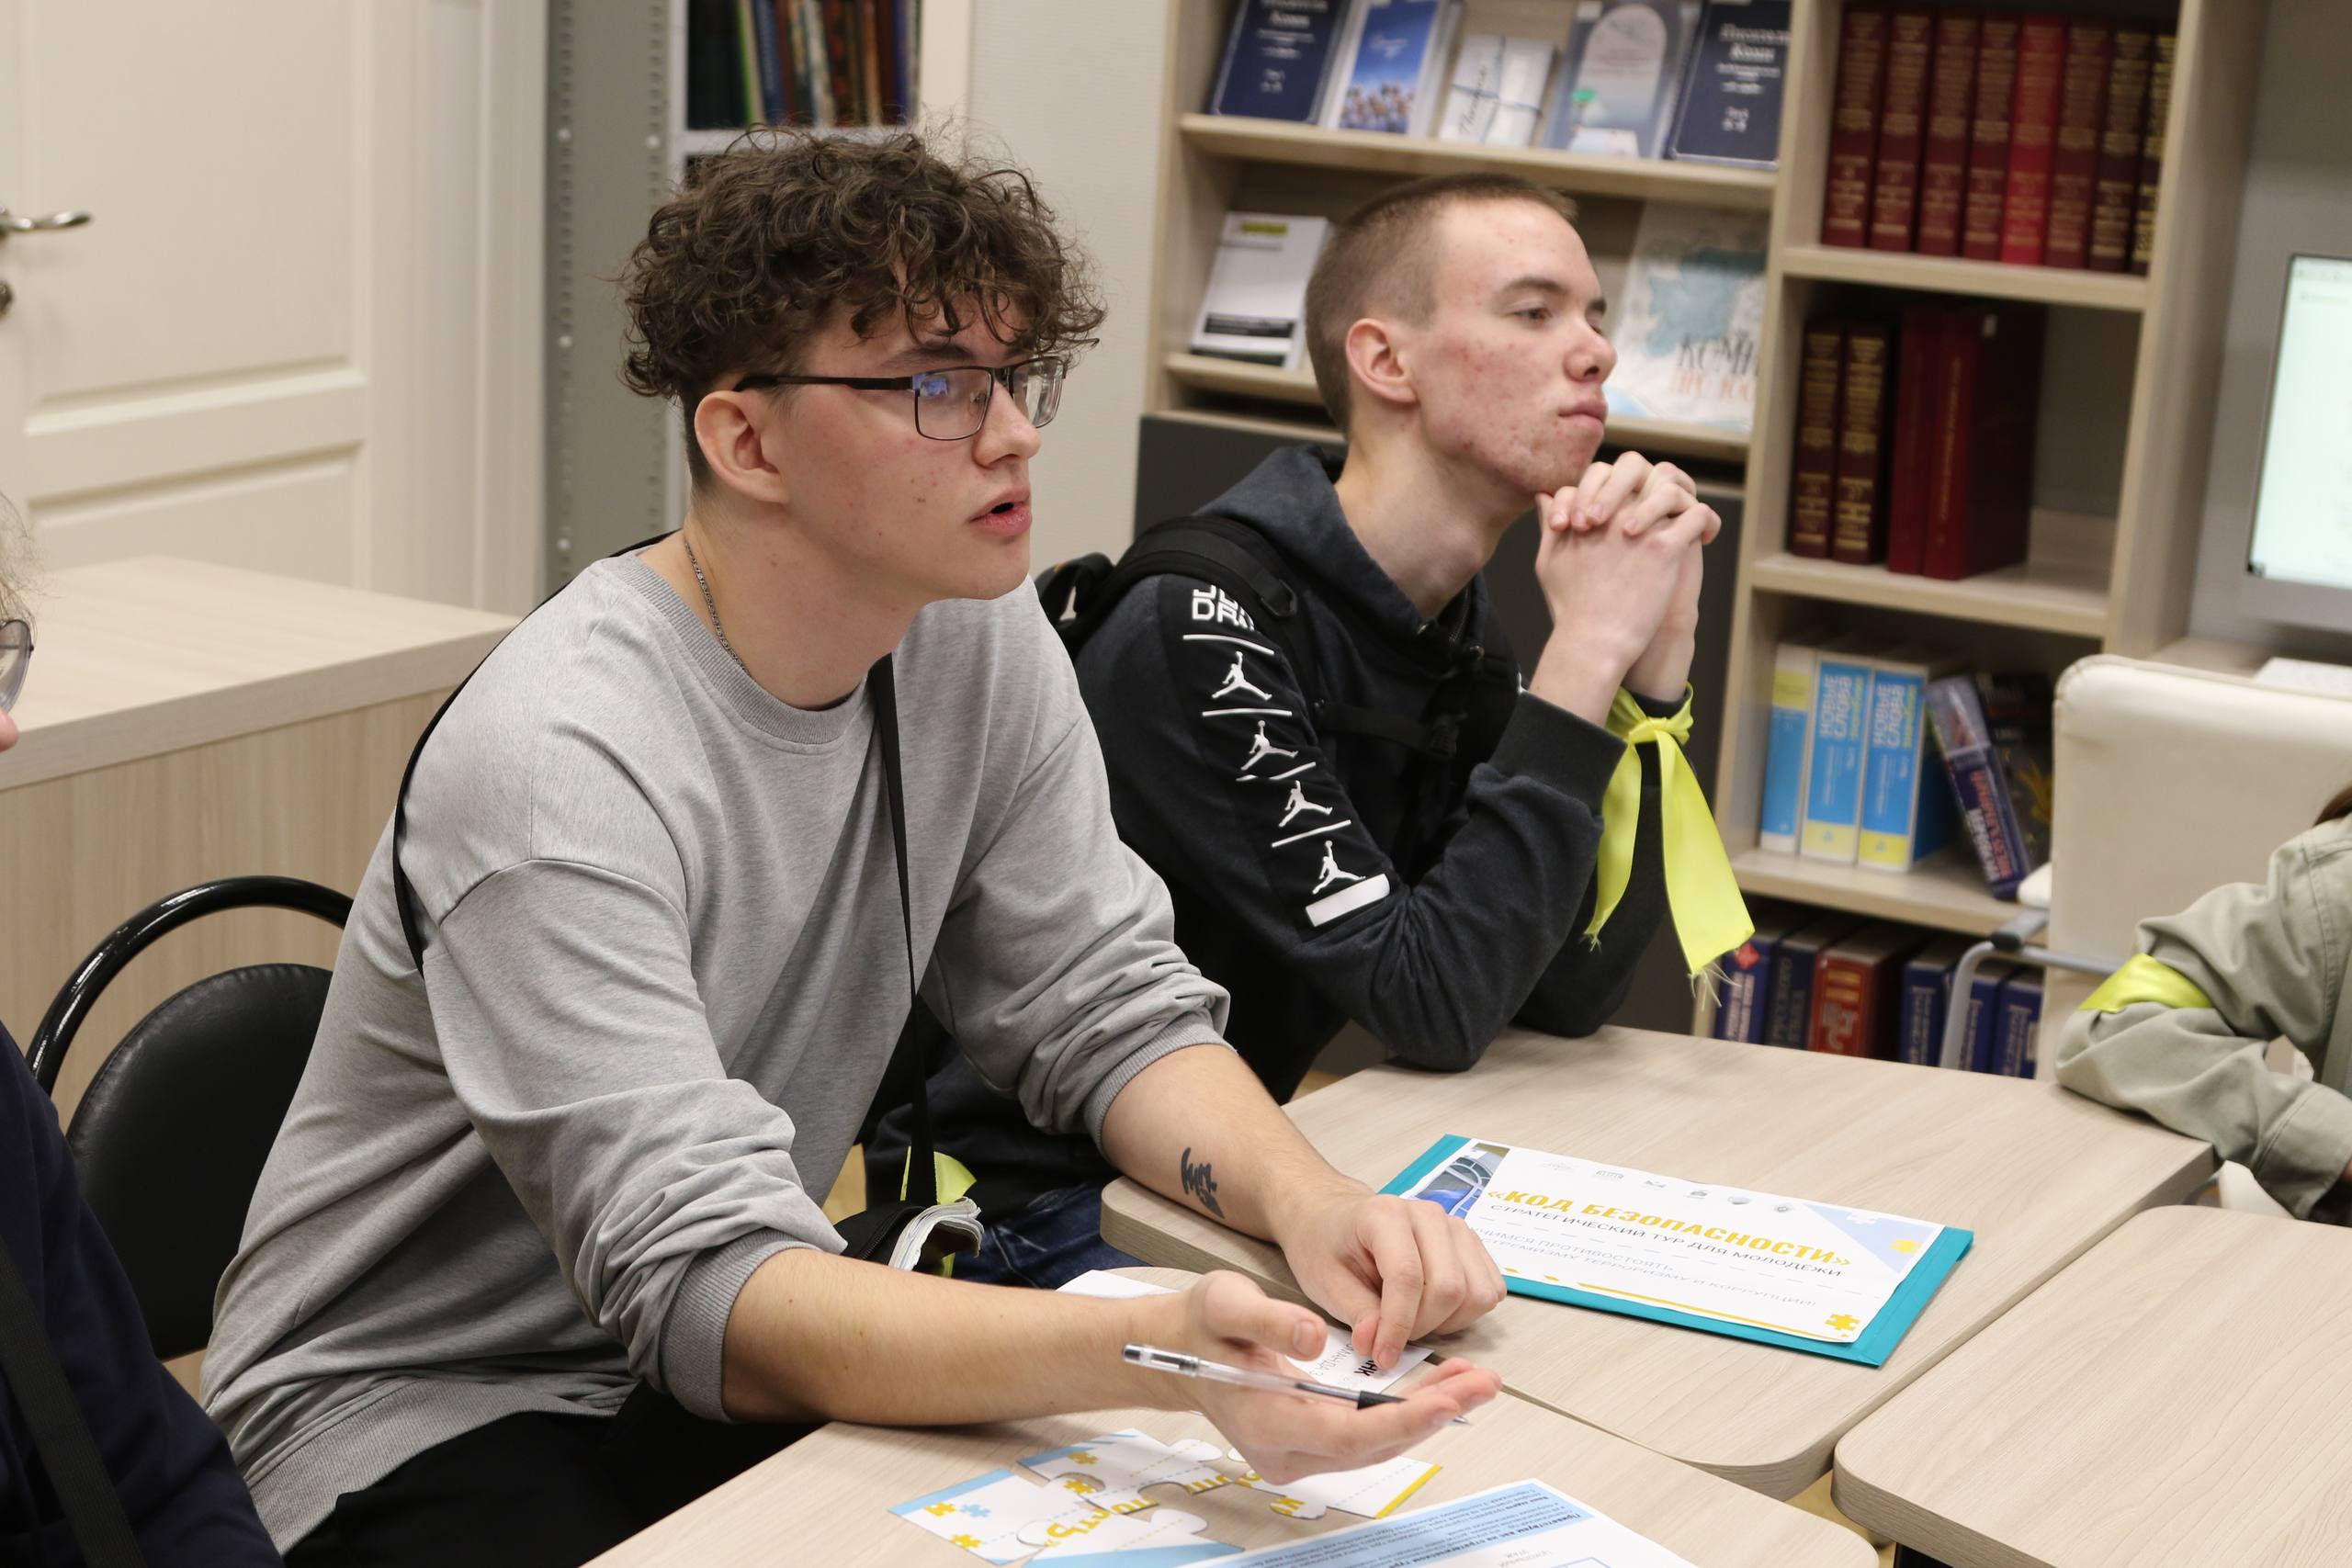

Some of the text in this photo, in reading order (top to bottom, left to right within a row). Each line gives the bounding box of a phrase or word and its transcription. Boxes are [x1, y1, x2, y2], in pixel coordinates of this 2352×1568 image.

[1487, 1190, 1851, 1267] «КОД БЕЗОПАСНОСТИ»
[1490, 1204, 1646, 1238] СТРАТЕГИЧЕСКИЙ
[1653, 1233, 1685, 1244] ТУР
[1687, 1240, 1728, 1256] ДЛЯ
[1538, 1236, 1675, 1271] ПРОТИВОСТОЯТЬ
